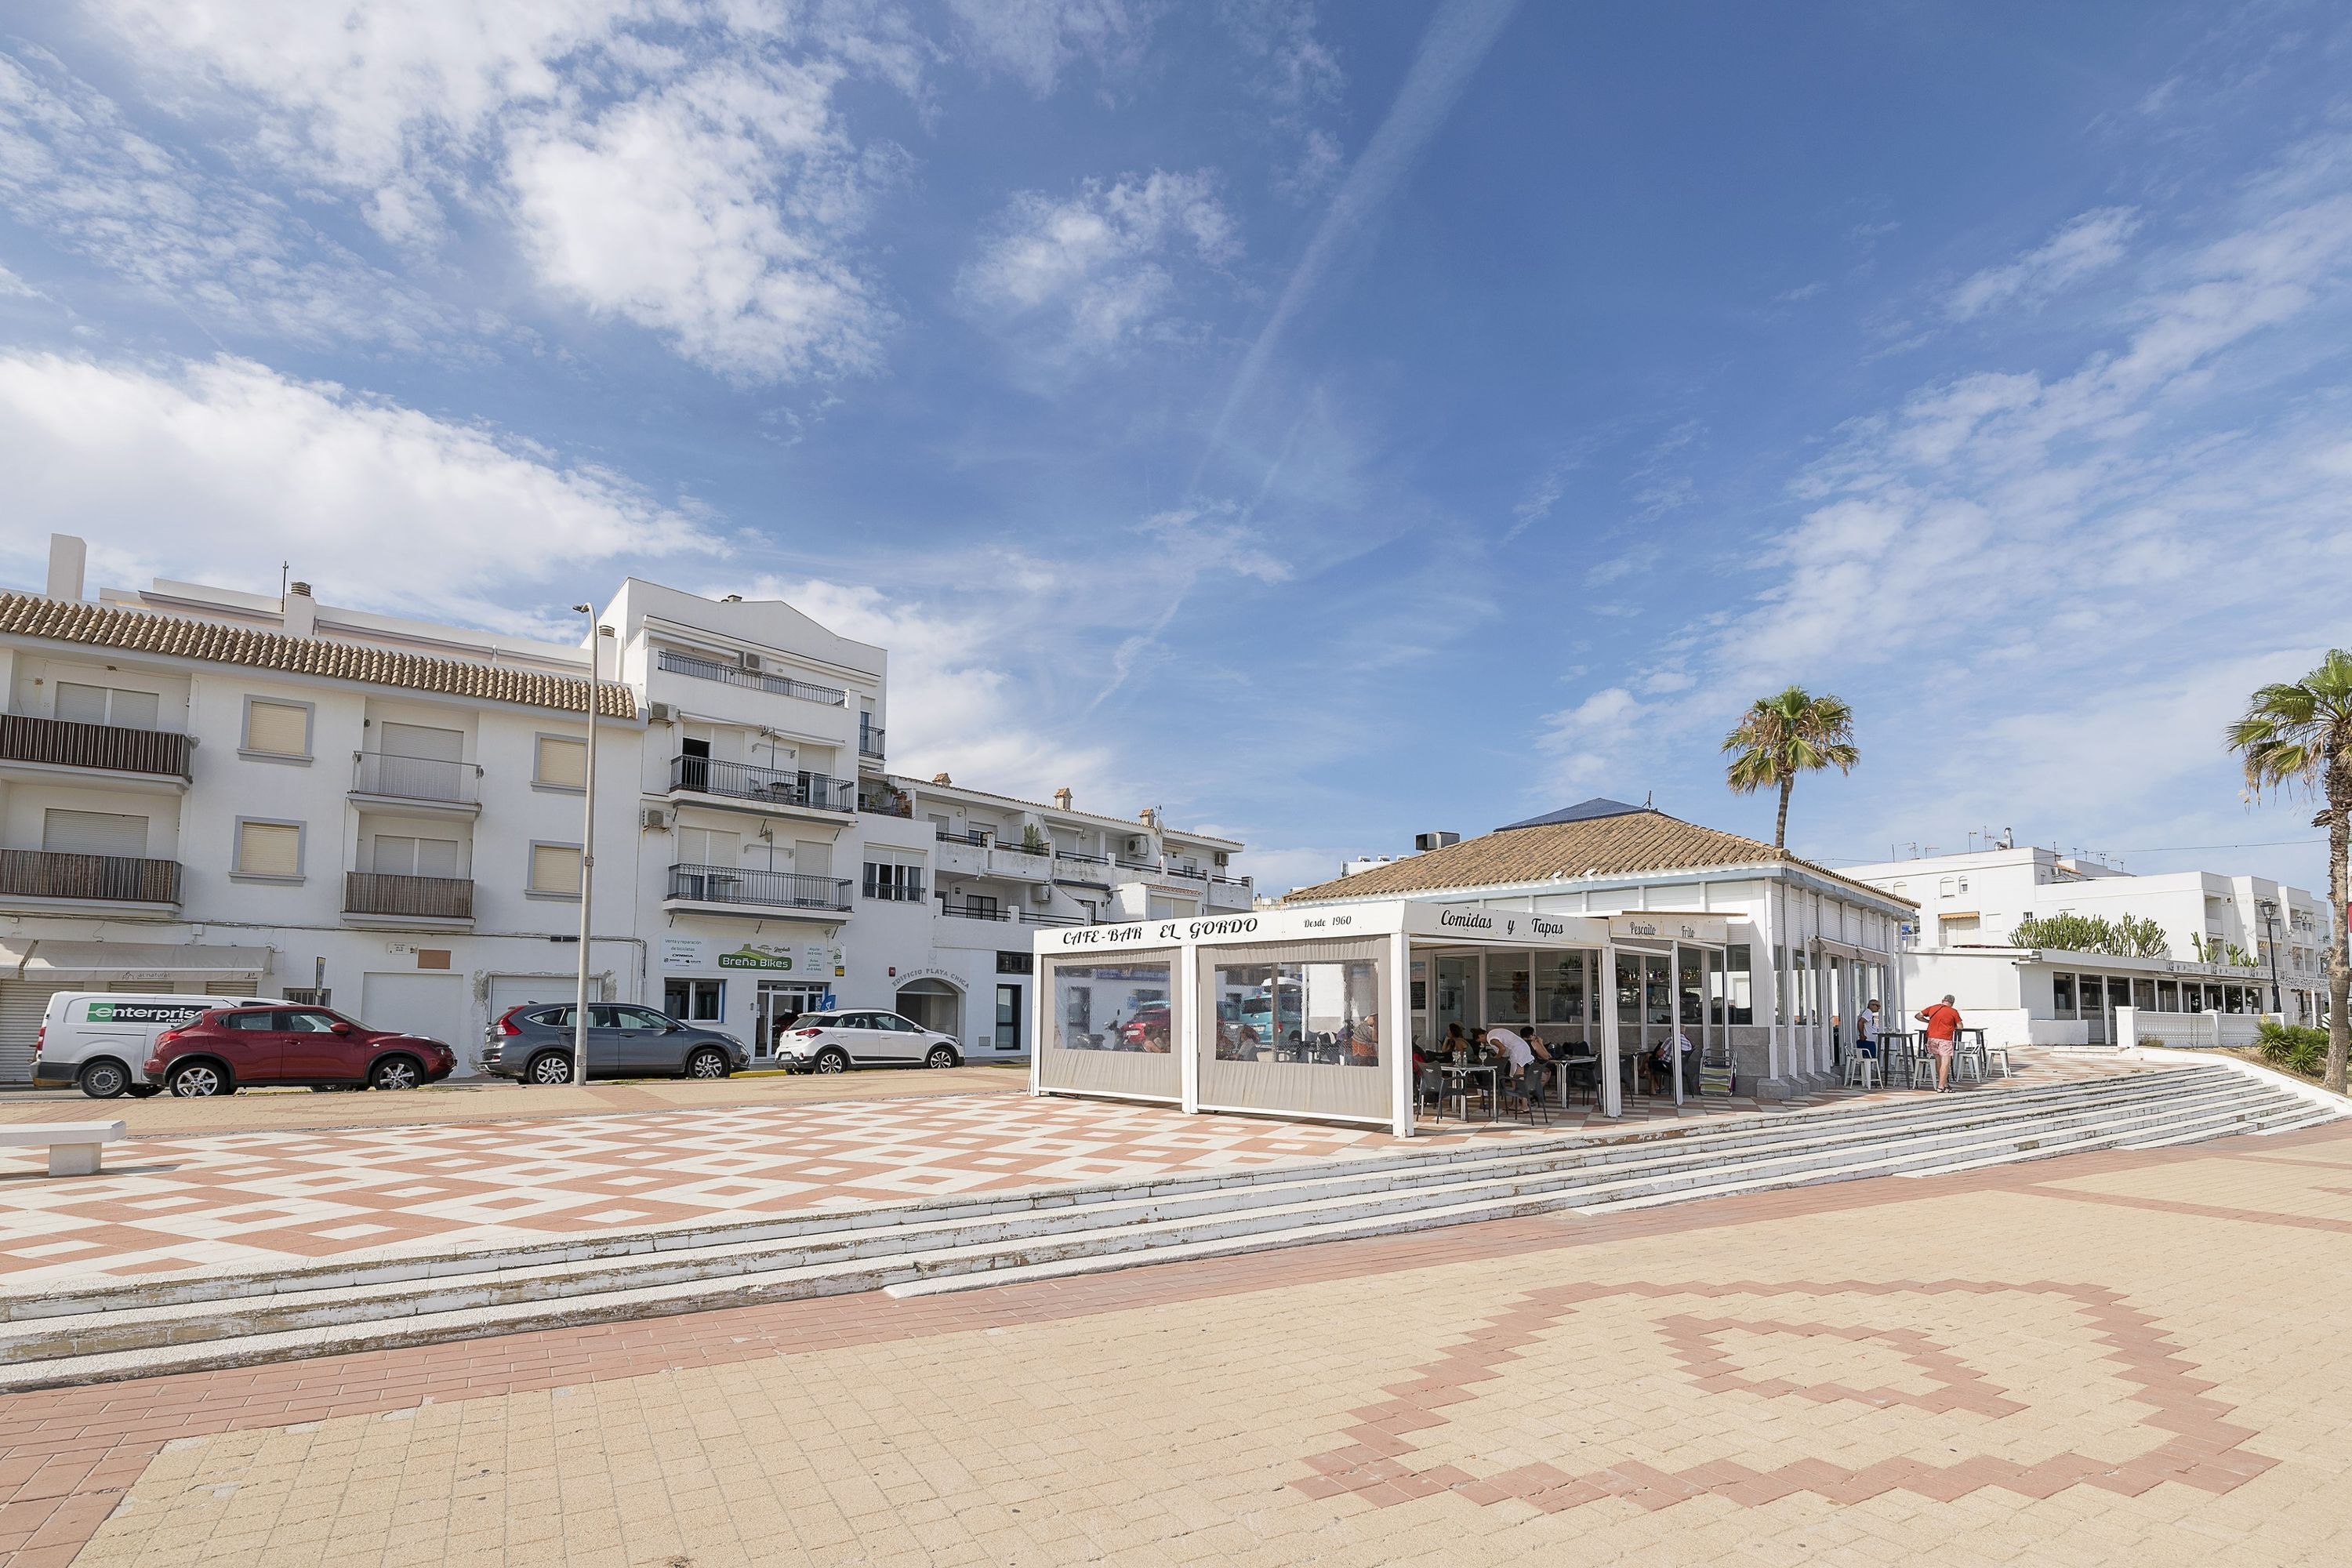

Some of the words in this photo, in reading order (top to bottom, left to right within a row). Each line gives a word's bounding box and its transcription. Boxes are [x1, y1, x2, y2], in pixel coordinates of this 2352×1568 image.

[1303, 918, 1326, 928] Desde
[1332, 915, 1352, 926] 1960
[1440, 909, 1493, 929] Comidas
[1507, 919, 1515, 935] y
[1531, 917, 1564, 938] Tapas
[1063, 926, 1142, 946] CAFE-BAR
[1159, 924, 1181, 940] EL
[1189, 917, 1258, 939] GORDO
[1681, 925, 1695, 938] Frito
[722, 956, 757, 967] Breña
[760, 958, 789, 968] Bikes
[891, 969, 923, 987] EDIFICIO
[950, 974, 970, 989] CHICA
